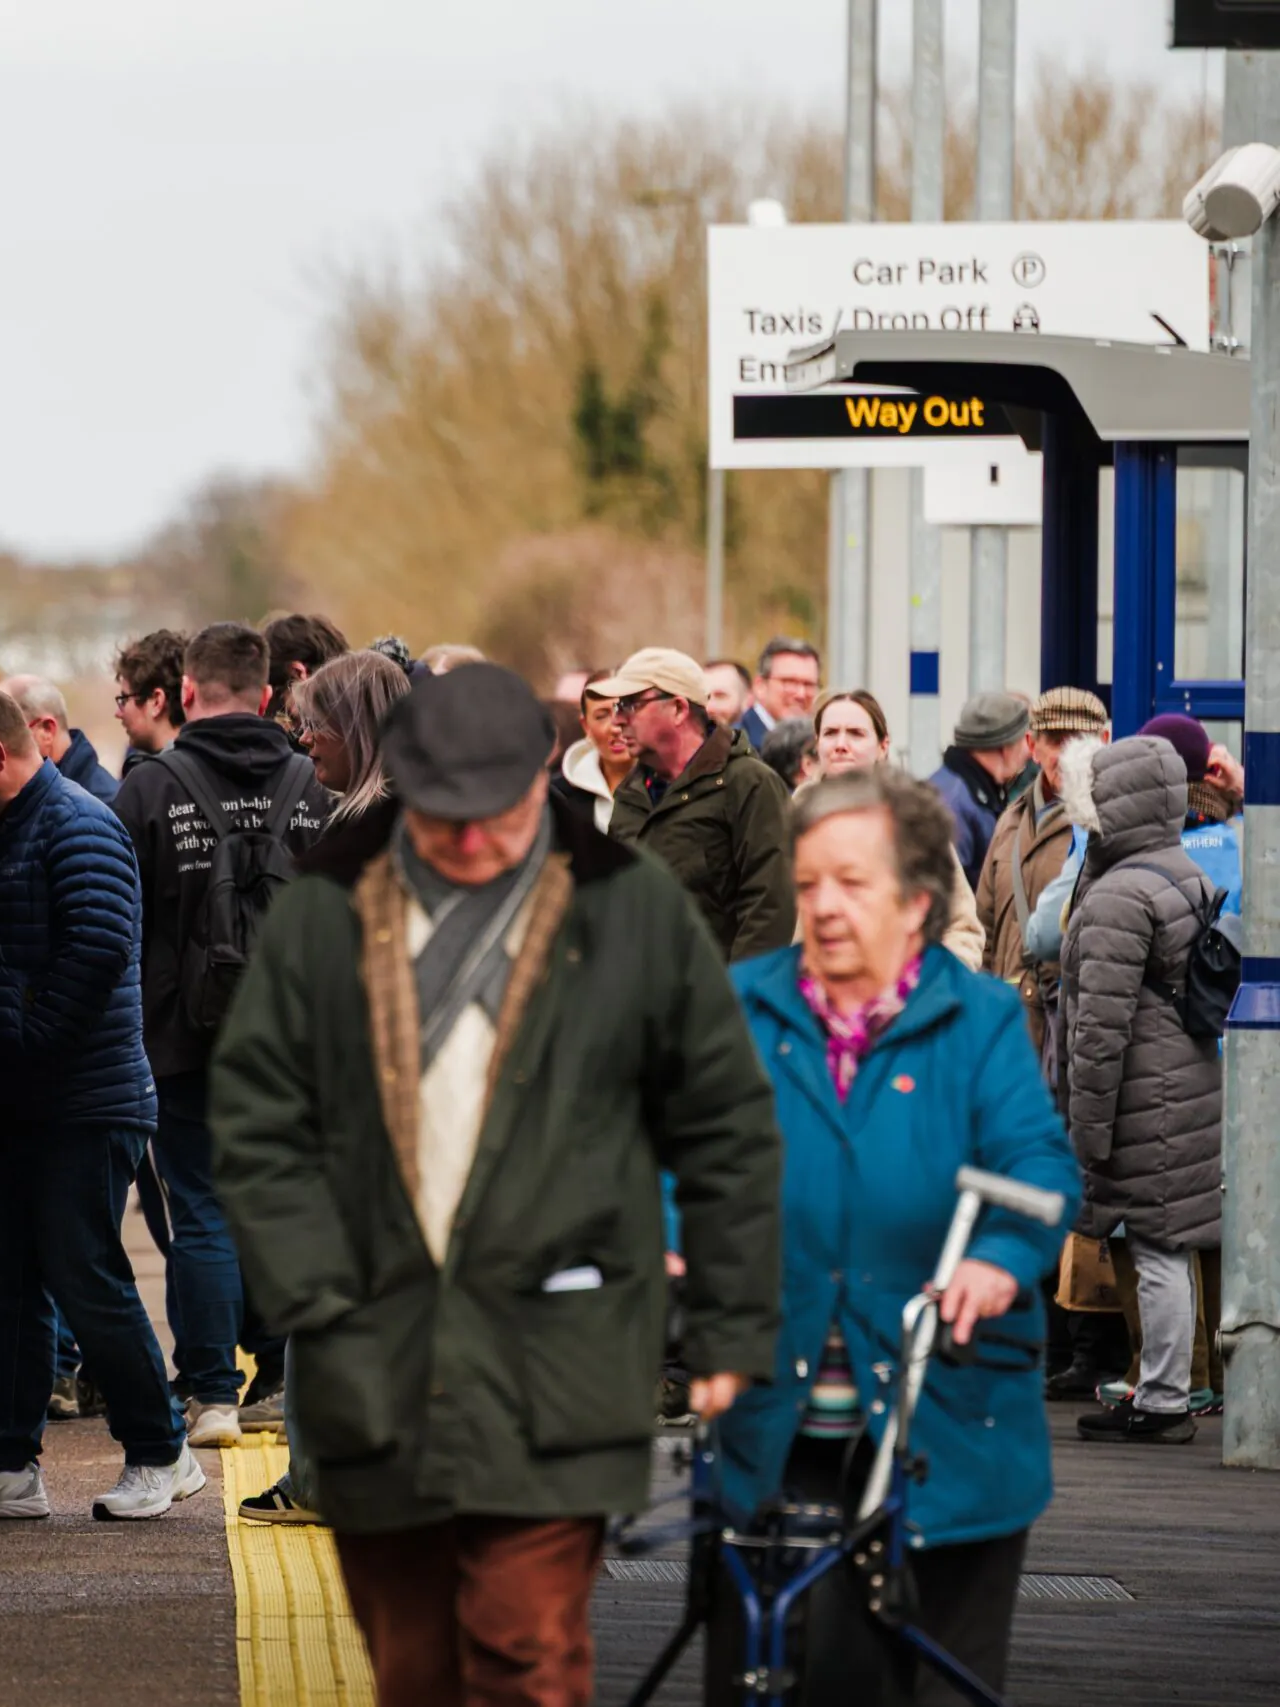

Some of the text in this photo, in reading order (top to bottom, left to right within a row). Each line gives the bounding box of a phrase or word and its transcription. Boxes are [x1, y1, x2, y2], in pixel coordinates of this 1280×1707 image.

[853, 259, 908, 286] Car
[918, 256, 988, 285] Park
[743, 308, 823, 335] Taxis
[940, 305, 992, 331] Off
[845, 395, 985, 433] Way Out
[168, 802, 196, 818] dear
[172, 820, 191, 835] the
[290, 813, 320, 831] place
[175, 834, 218, 852] with yo
